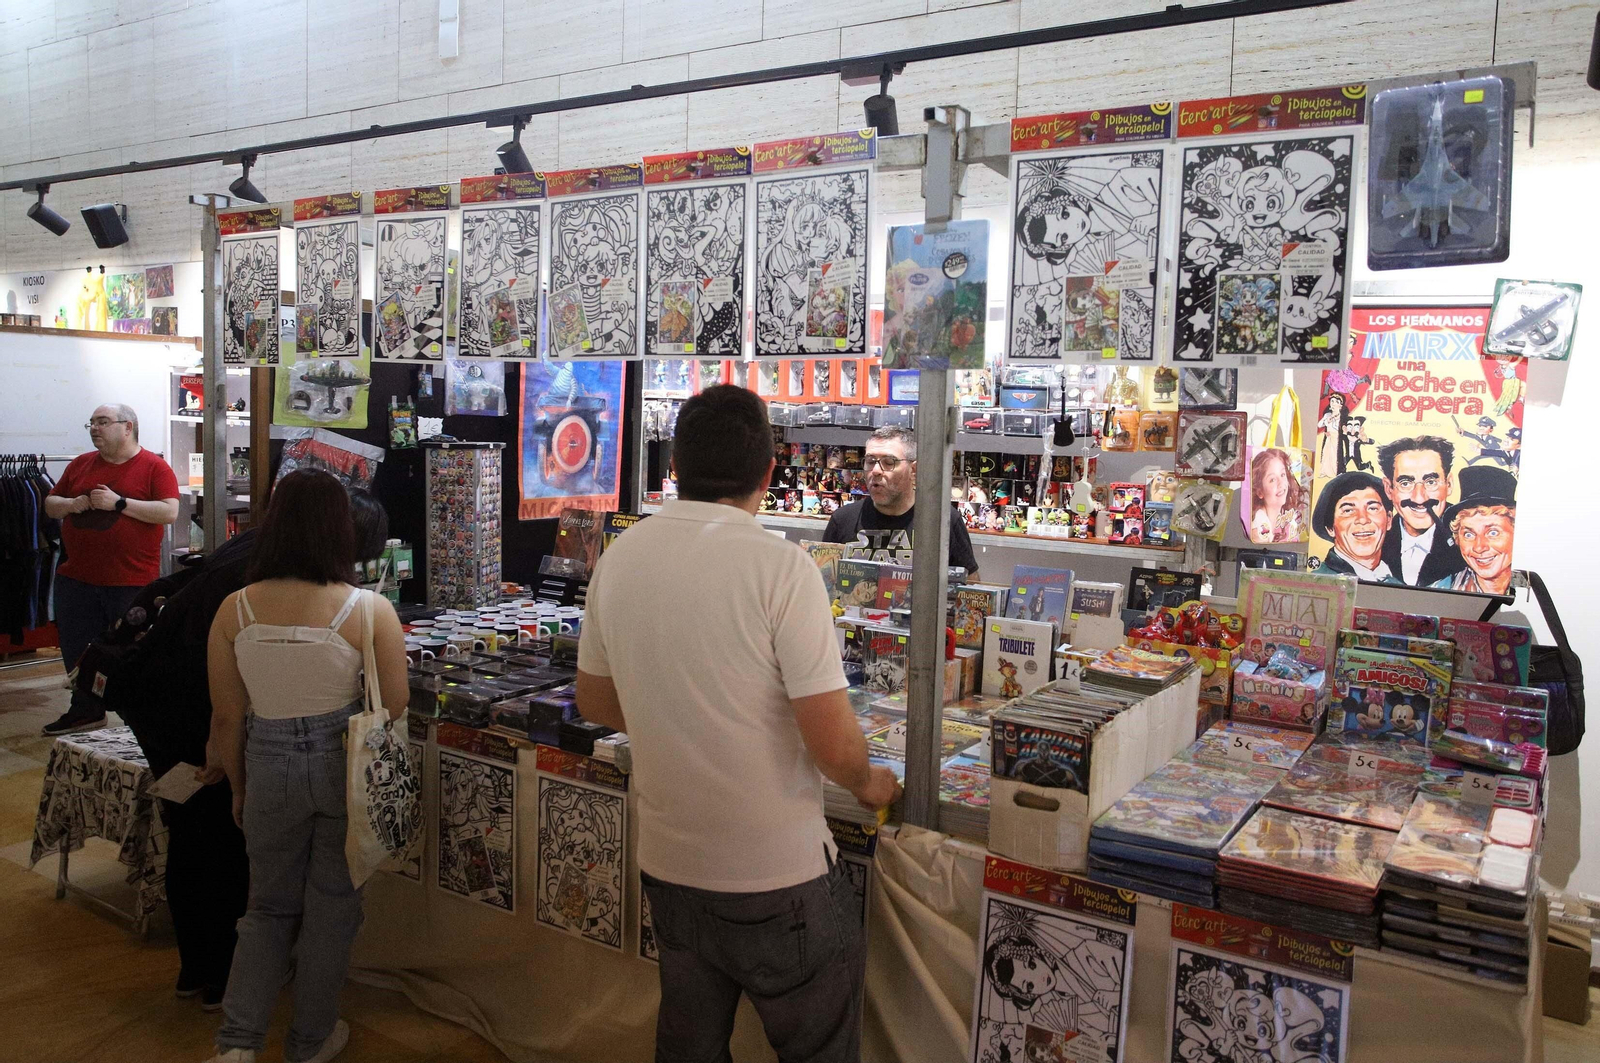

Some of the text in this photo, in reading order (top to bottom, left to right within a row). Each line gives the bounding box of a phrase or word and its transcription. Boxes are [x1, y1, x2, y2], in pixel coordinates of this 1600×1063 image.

[1288, 98, 1331, 113] ¡Dibujos
[1299, 104, 1357, 120] terciopelo!
[1105, 114, 1142, 128] ¡Dibujos
[1115, 120, 1164, 136] terciopelo!
[823, 136, 852, 149] ¡Dibujos
[832, 142, 868, 156] terciopelo!
[707, 154, 732, 165] ¡Dibujos
[22, 276, 45, 287] KIOSKO
[1369, 315, 1484, 327] LOS HERMANOS
[1361, 332, 1480, 360] MARX
[1397, 361, 1426, 372] una
[1374, 371, 1486, 394] noche en
[1366, 390, 1484, 422] la opera
[612, 519, 638, 528] CONA
[850, 530, 915, 550] STA
[958, 591, 984, 600] MUNDO
[1080, 598, 1106, 608] SUSHI
[999, 638, 1035, 656] TRIBULETE
[1356, 668, 1428, 692] AMIGOS!
[1019, 744, 1082, 766] AMRICA
[1073, 883, 1110, 900] ¡Dibujos
[1083, 898, 1130, 918] terciopelo!
[1277, 934, 1321, 954] ¡Dibujos
[1289, 950, 1346, 974] terciopelo!
